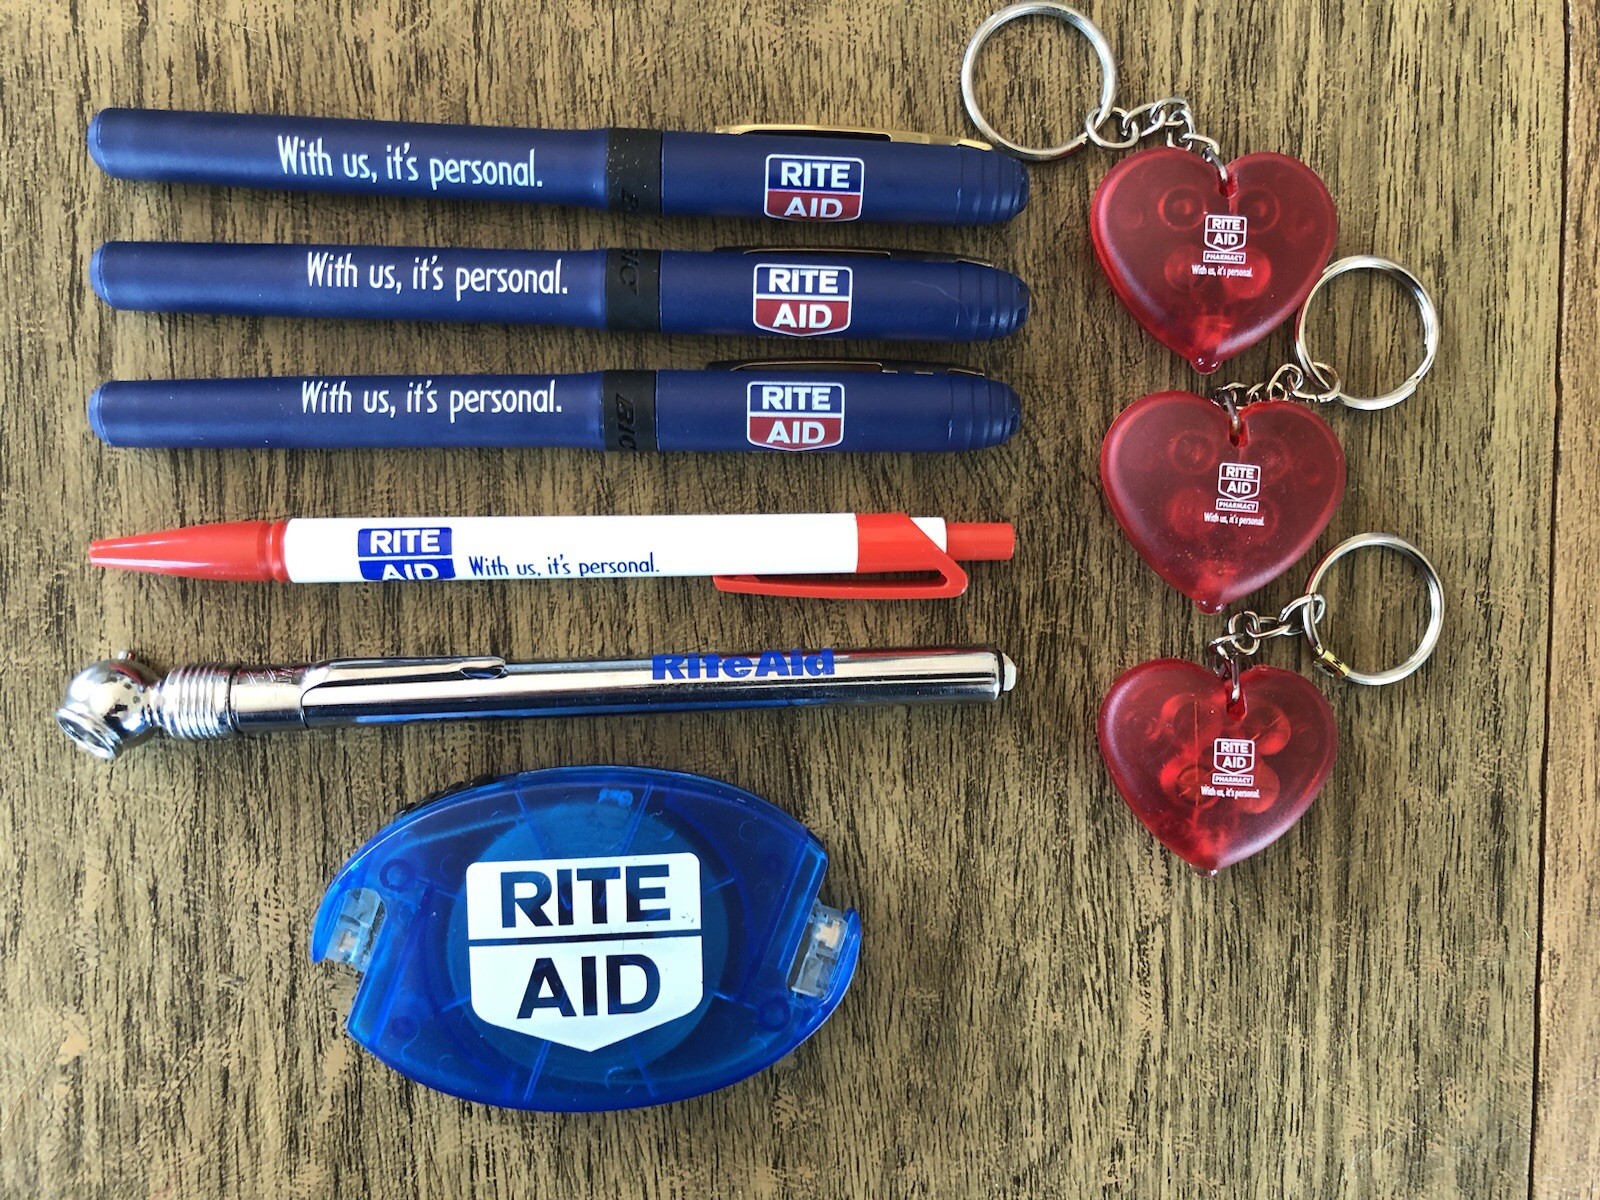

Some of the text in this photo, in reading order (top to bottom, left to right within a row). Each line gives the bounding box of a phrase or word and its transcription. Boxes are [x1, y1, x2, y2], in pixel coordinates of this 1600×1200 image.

[277, 134, 543, 191] With us, it's personal.
[780, 161, 850, 189] RITE
[783, 196, 843, 219] AID
[1211, 217, 1241, 231] RITE
[1213, 232, 1239, 246] AID
[1205, 253, 1244, 262] PHARMACY
[307, 251, 568, 302] With us, it's personal.
[768, 268, 839, 294] RITE
[1191, 264, 1253, 279] With us, it's personal.
[772, 303, 832, 329] AID
[301, 379, 562, 424] With us, it's personal.
[761, 385, 831, 411] RITE
[765, 420, 826, 444] AID
[1226, 466, 1255, 479] RITE
[1226, 481, 1252, 494] AID
[1218, 501, 1256, 511] PHARMACY
[1203, 511, 1265, 527] With us, it's personal.
[370, 529, 440, 554] RITE
[382, 563, 440, 581] AID
[468, 551, 661, 577] With us, it's personal.
[652, 648, 835, 680] RiteAid
[1220, 741, 1249, 754] RITE
[1221, 755, 1247, 768] AID
[1214, 776, 1252, 785] PHARMACY
[1200, 785, 1260, 800] With us, it's personal.
[499, 863, 671, 929] RITE
[516, 953, 662, 1020] AID
